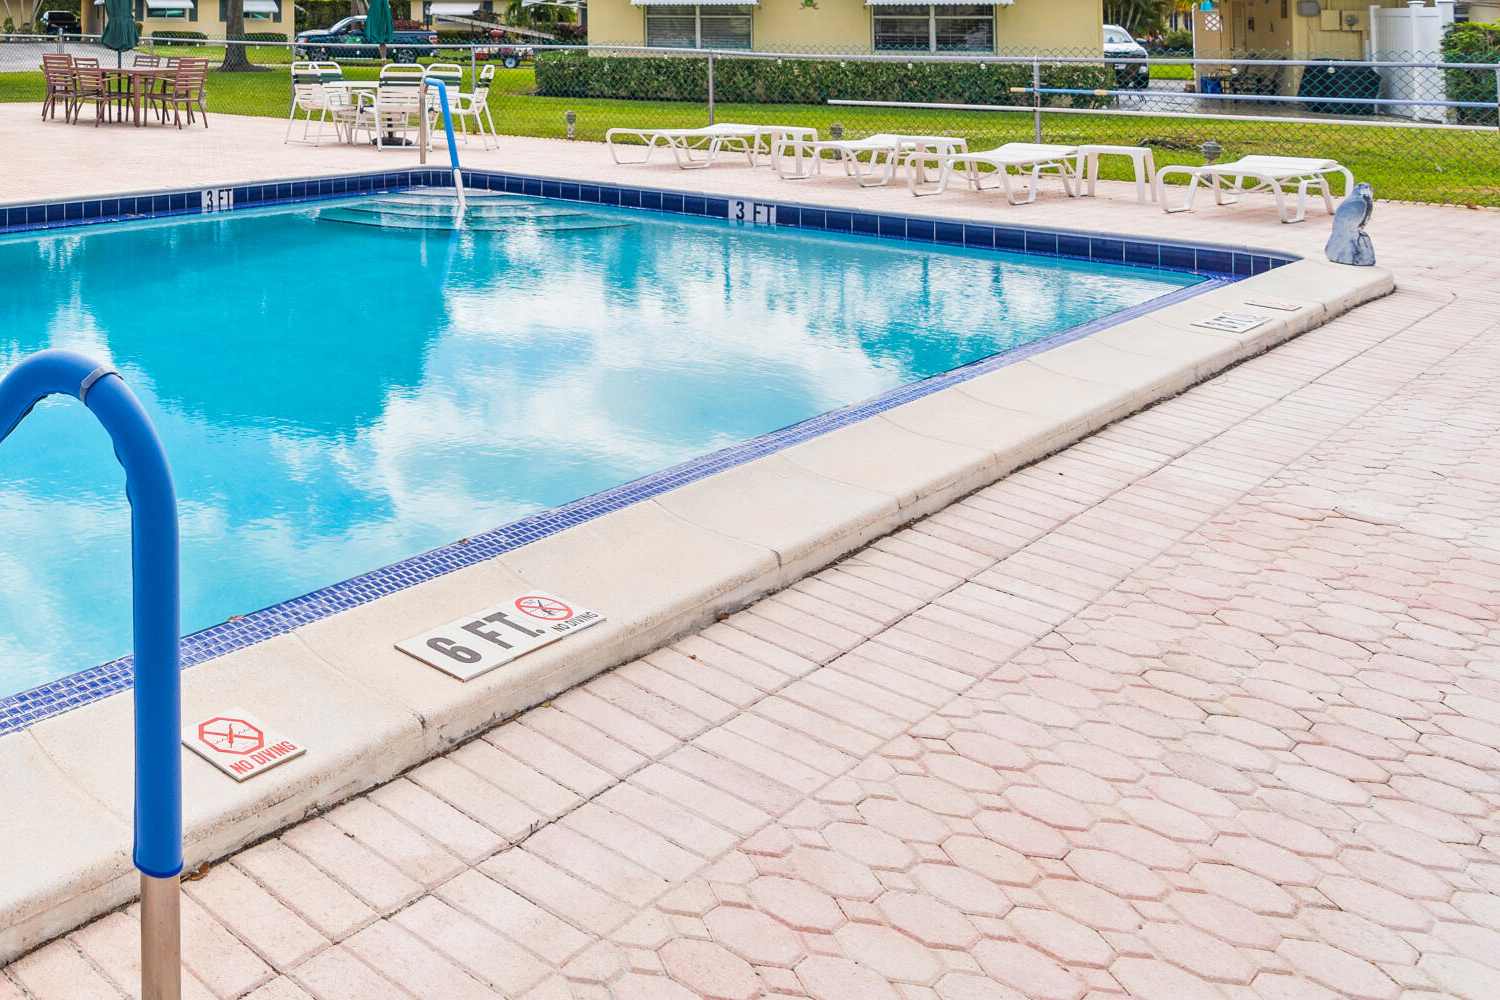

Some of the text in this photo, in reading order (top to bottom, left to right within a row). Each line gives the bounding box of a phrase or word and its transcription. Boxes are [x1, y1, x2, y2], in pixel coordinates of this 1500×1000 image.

[206, 188, 232, 212] 3 FT
[736, 201, 774, 225] 3 FT
[551, 611, 599, 633] NO DIVING
[426, 611, 546, 664] 6 FT.
[228, 740, 298, 775] NO DIVING
